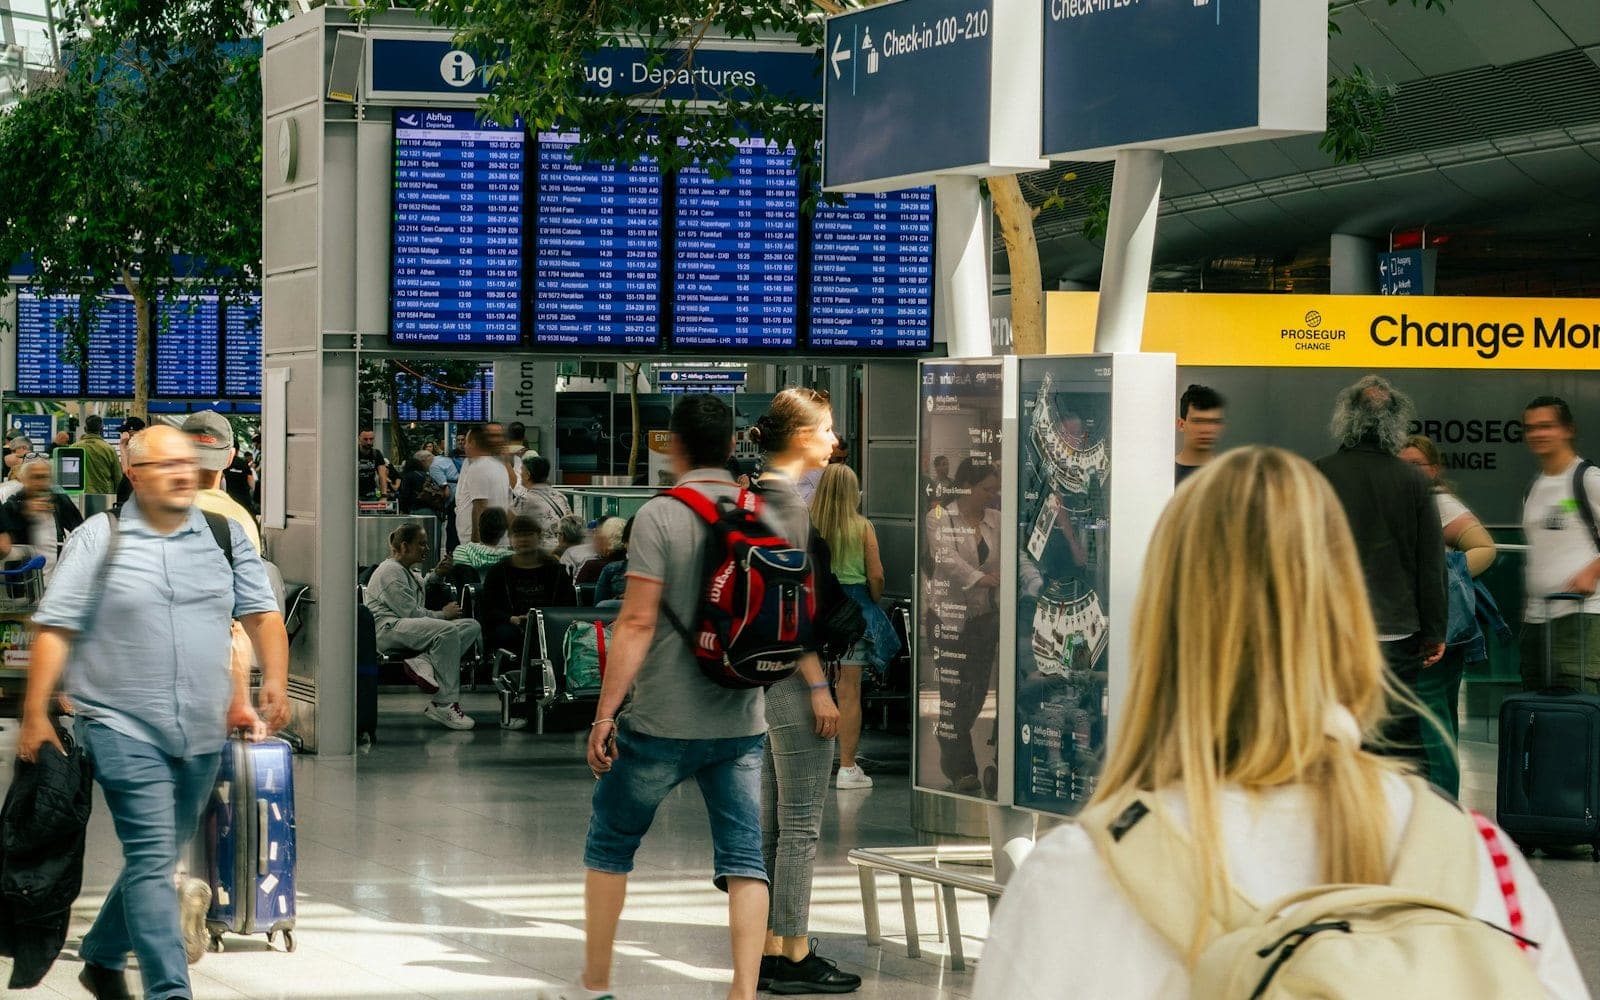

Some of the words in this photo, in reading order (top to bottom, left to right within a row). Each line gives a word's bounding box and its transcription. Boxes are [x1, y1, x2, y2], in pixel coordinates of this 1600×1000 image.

[883, 22, 932, 57] Check-in
[632, 62, 756, 86] Departures
[426, 113, 452, 123] Abflug
[1281, 329, 1346, 340] PROSEGUR
[1370, 314, 1524, 359] Change
[1295, 342, 1331, 350] CHANGE
[1408, 420, 1523, 444] PROSEG
[1440, 452, 1496, 470] ANGE
